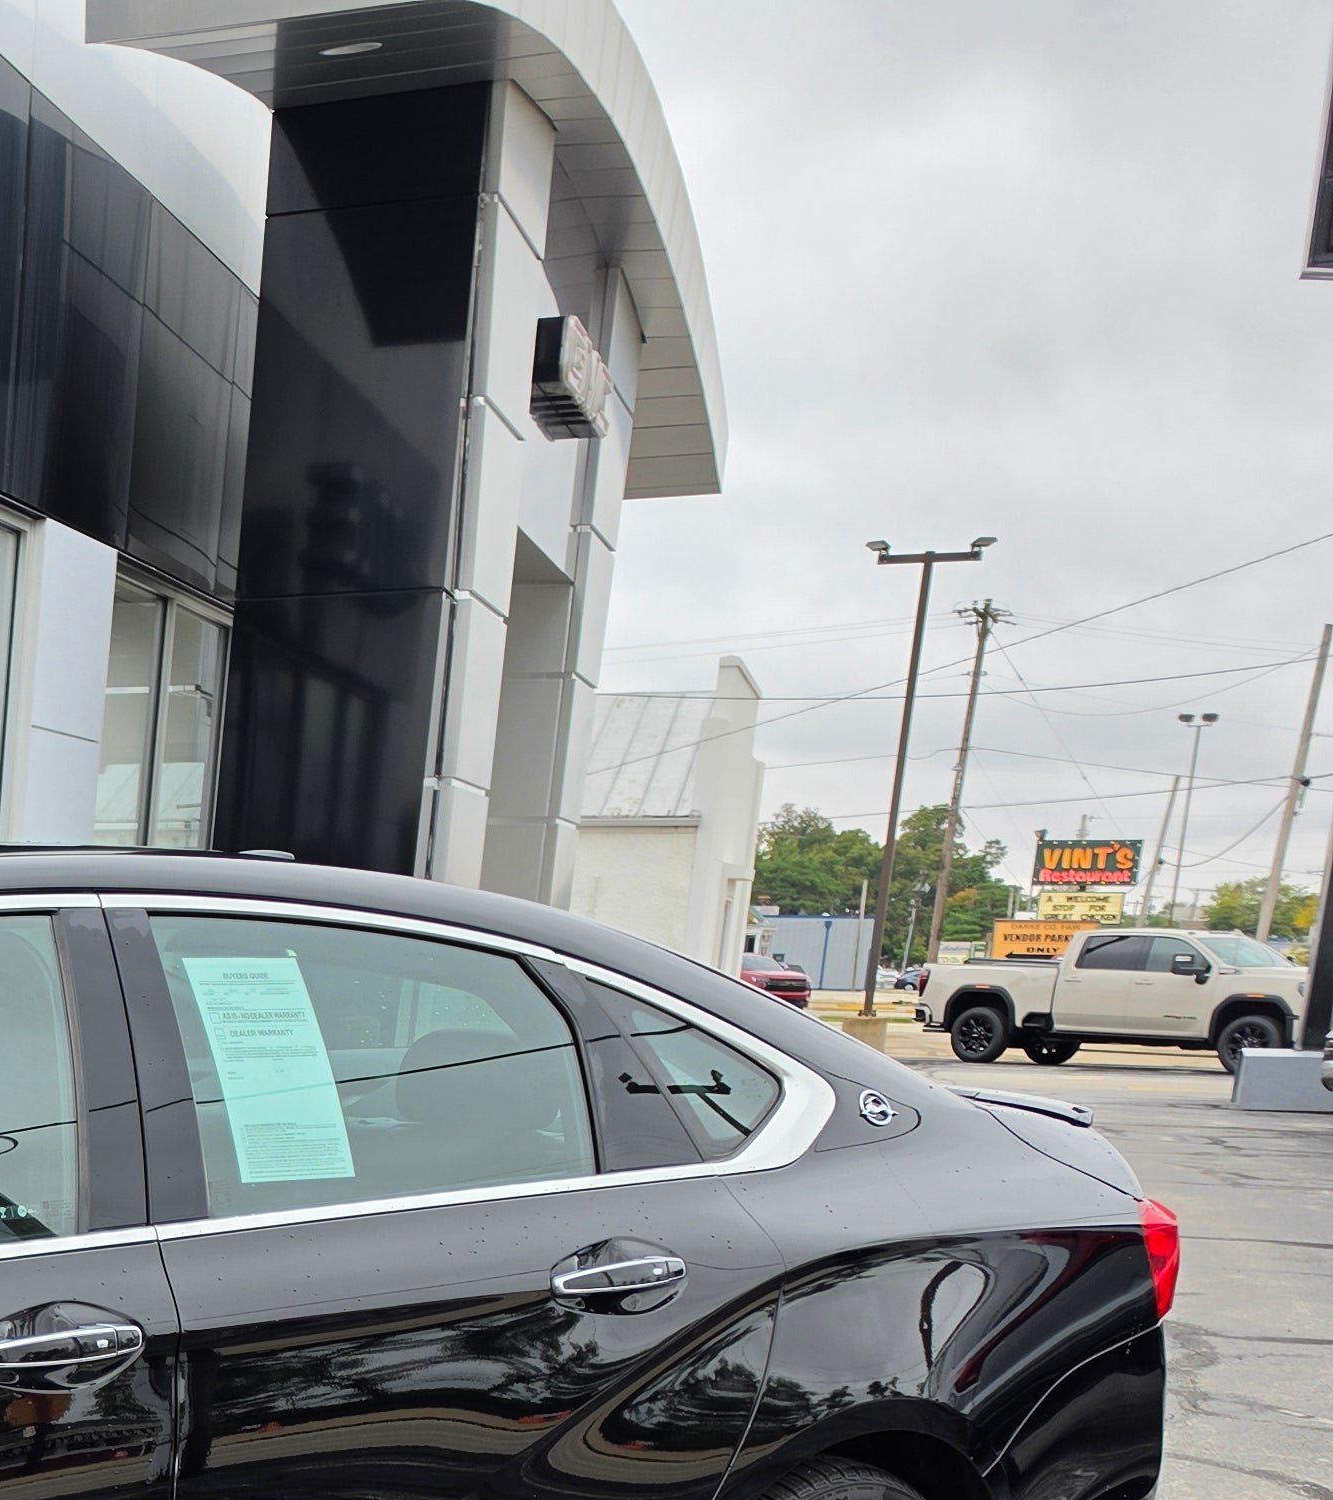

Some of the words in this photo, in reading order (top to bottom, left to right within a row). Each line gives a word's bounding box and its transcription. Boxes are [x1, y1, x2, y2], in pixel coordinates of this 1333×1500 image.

[1043, 843, 1136, 870] VINT'S
[1039, 869, 1131, 882] Restaurant
[1046, 895, 1054, 903] A
[1066, 895, 1112, 904] WELCOME
[1052, 904, 1076, 912] STOP
[1088, 904, 1107, 912] FOR
[1043, 913, 1073, 921] GREAT
[1080, 913, 1118, 921] CHICKEN
[1003, 934, 1042, 943] VENDOR
[222, 972, 249, 980] BUYERS
[249, 972, 270, 980] GUIDE
[250, 1011, 273, 1020] DEALER
[274, 1011, 306, 1019] WARRANTY
[229, 1029, 256, 1038] DEALER
[257, 1029, 294, 1037] WARRANTY
